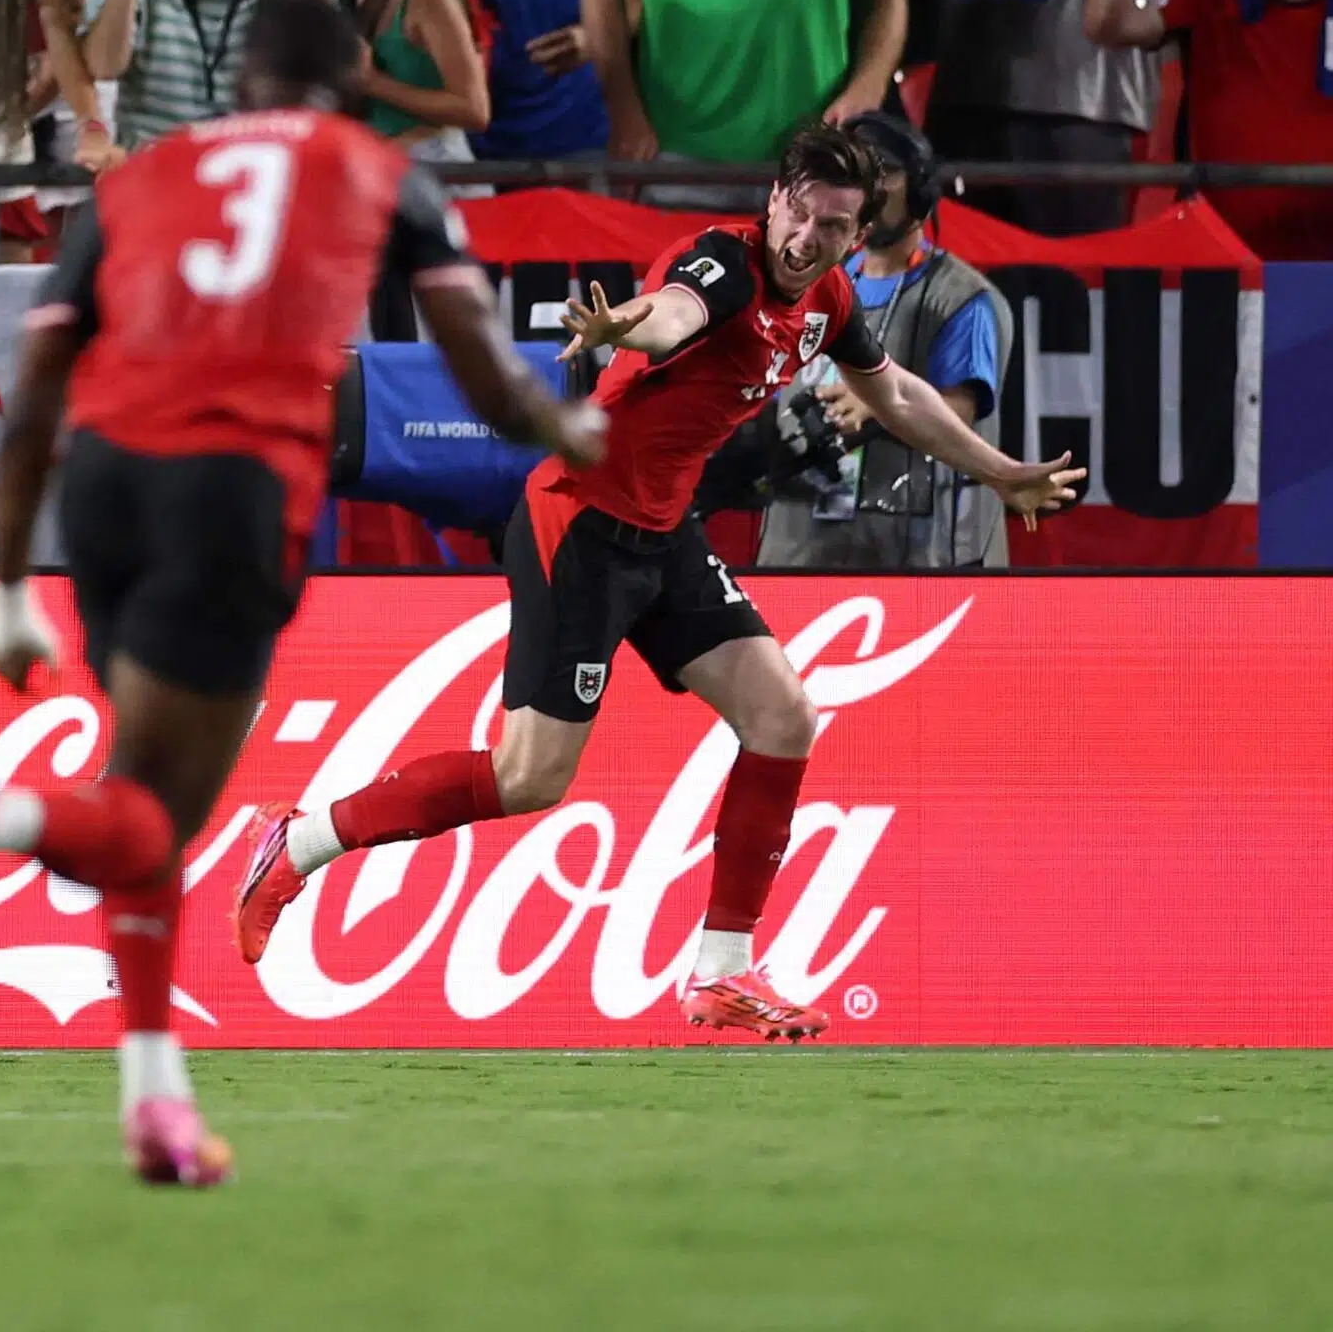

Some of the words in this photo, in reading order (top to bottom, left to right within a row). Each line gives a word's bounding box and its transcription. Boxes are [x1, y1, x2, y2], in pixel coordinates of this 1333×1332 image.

[179, 142, 297, 300] 3
[403, 421, 436, 438] FIFA
[437, 421, 490, 438] WORLD
